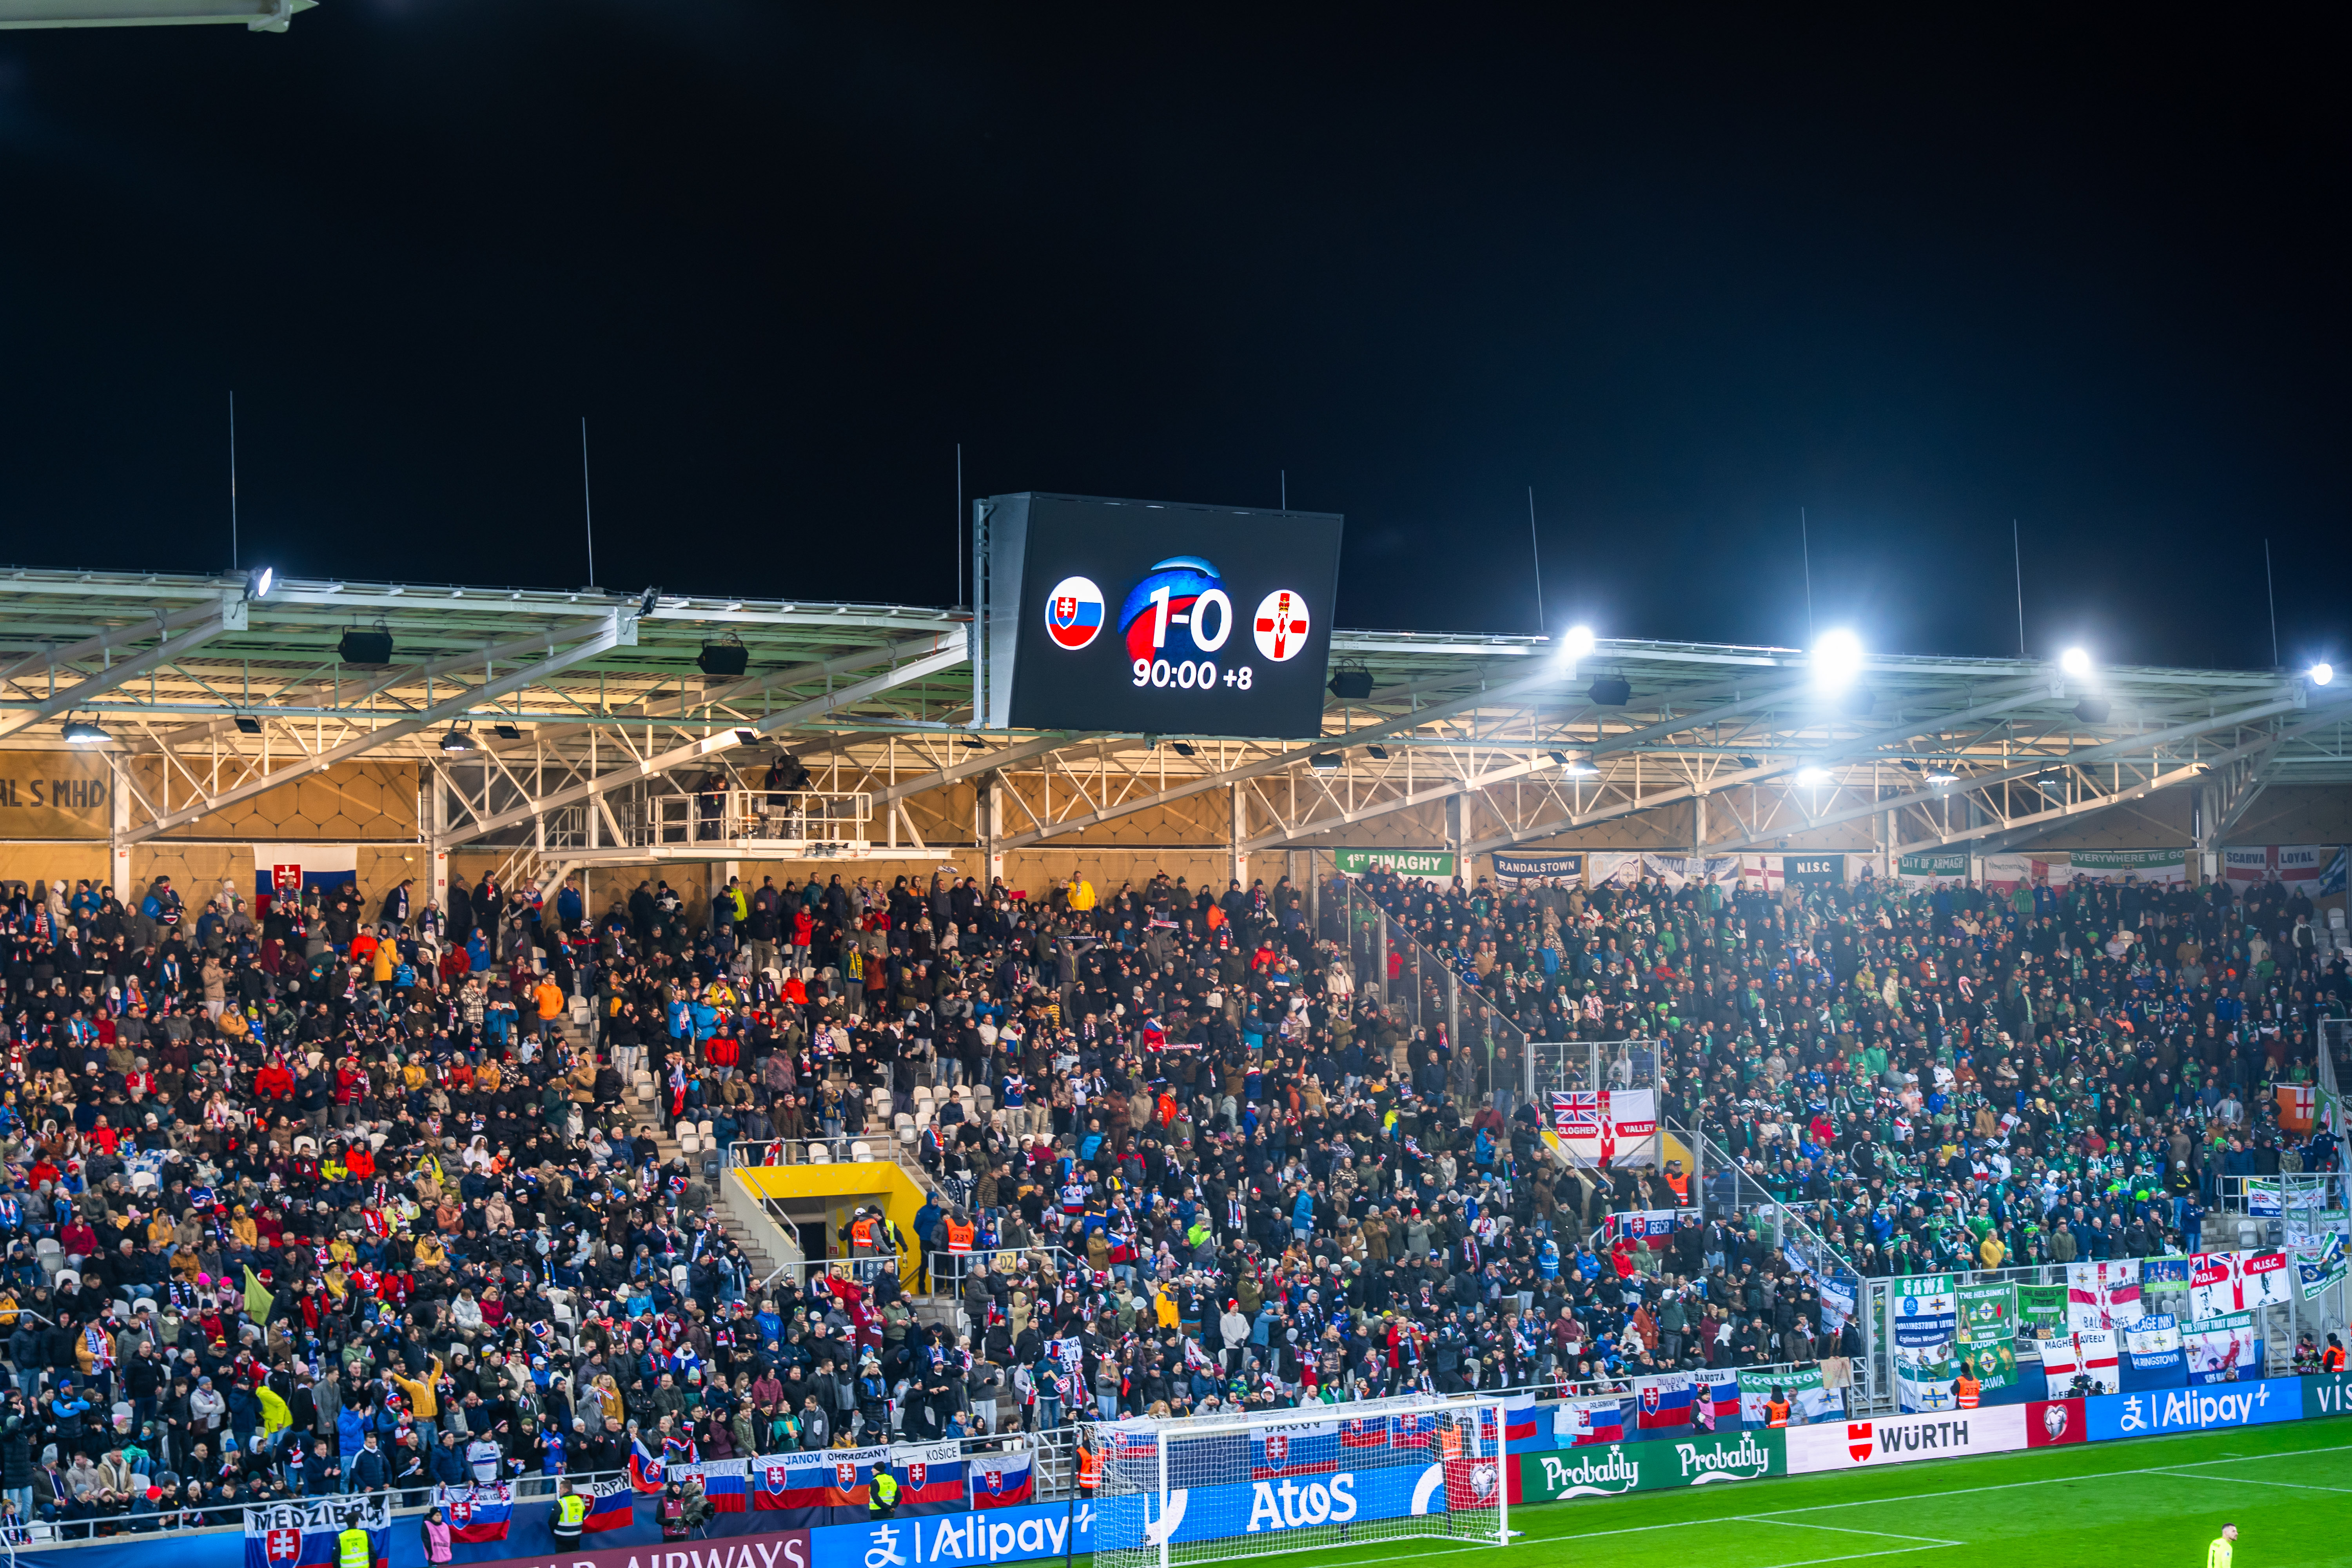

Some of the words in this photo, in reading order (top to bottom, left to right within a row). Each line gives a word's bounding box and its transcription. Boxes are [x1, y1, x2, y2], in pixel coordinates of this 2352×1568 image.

[1149, 586, 1232, 652] 1-0
[1132, 659, 1216, 690] 90:00
[1223, 667, 1252, 690] +8
[30, 780, 44, 807] S
[53, 780, 105, 808] MHD
[1369, 855, 1442, 871] FINAGHY
[1921, 859, 1930, 869] OF
[1933, 857, 1963, 869] ARMAGH
[2071, 853, 2145, 862] EVERYWHERE
[2148, 853, 2165, 861] WE
[2169, 850, 2185, 859] GO
[2227, 852, 2265, 864] SCARVA
[2281, 852, 2314, 864] LOYAL
[1499, 860, 1575, 873] RANDALSTOWN
[1797, 862, 1832, 873] N.I.S.C.
[1558, 1126, 1597, 1134] CLOGHER
[1623, 1124, 1654, 1133] VALLEY
[1650, 1220, 1669, 1234] GEČA
[1000, 1255, 1013, 1269] D2
[2253, 1258, 2279, 1271] N.I.S.C.
[2196, 1272, 2218, 1284] P.D.L.
[1903, 1277, 1944, 1295] GAWA
[2307, 1287, 2321, 1296] EAST
[1973, 1289, 2005, 1299] HELSINKI
[2128, 1317, 2156, 1332] ILLAGE
[2158, 1315, 2172, 1329] INN
[2180, 1323, 2193, 1333] THE
[2193, 1321, 2210, 1332] STUFF
[2210, 1318, 2226, 1330] THAT
[2227, 1314, 2251, 1328] DREAMS
[1657, 1376, 1686, 1386] DULOVA
[1742, 1370, 1823, 1386] COOKSTOW
[1978, 1375, 2005, 1391] GAWA
[1879, 1420, 1968, 1453] WÜRTH
[785, 1454, 821, 1465] JANOV
[828, 1449, 887, 1461] OHRADZANY
[926, 1446, 957, 1461] KOŠICE
[1675, 1439, 1769, 1477] Probably
[1540, 1452, 1639, 1490] Probably
